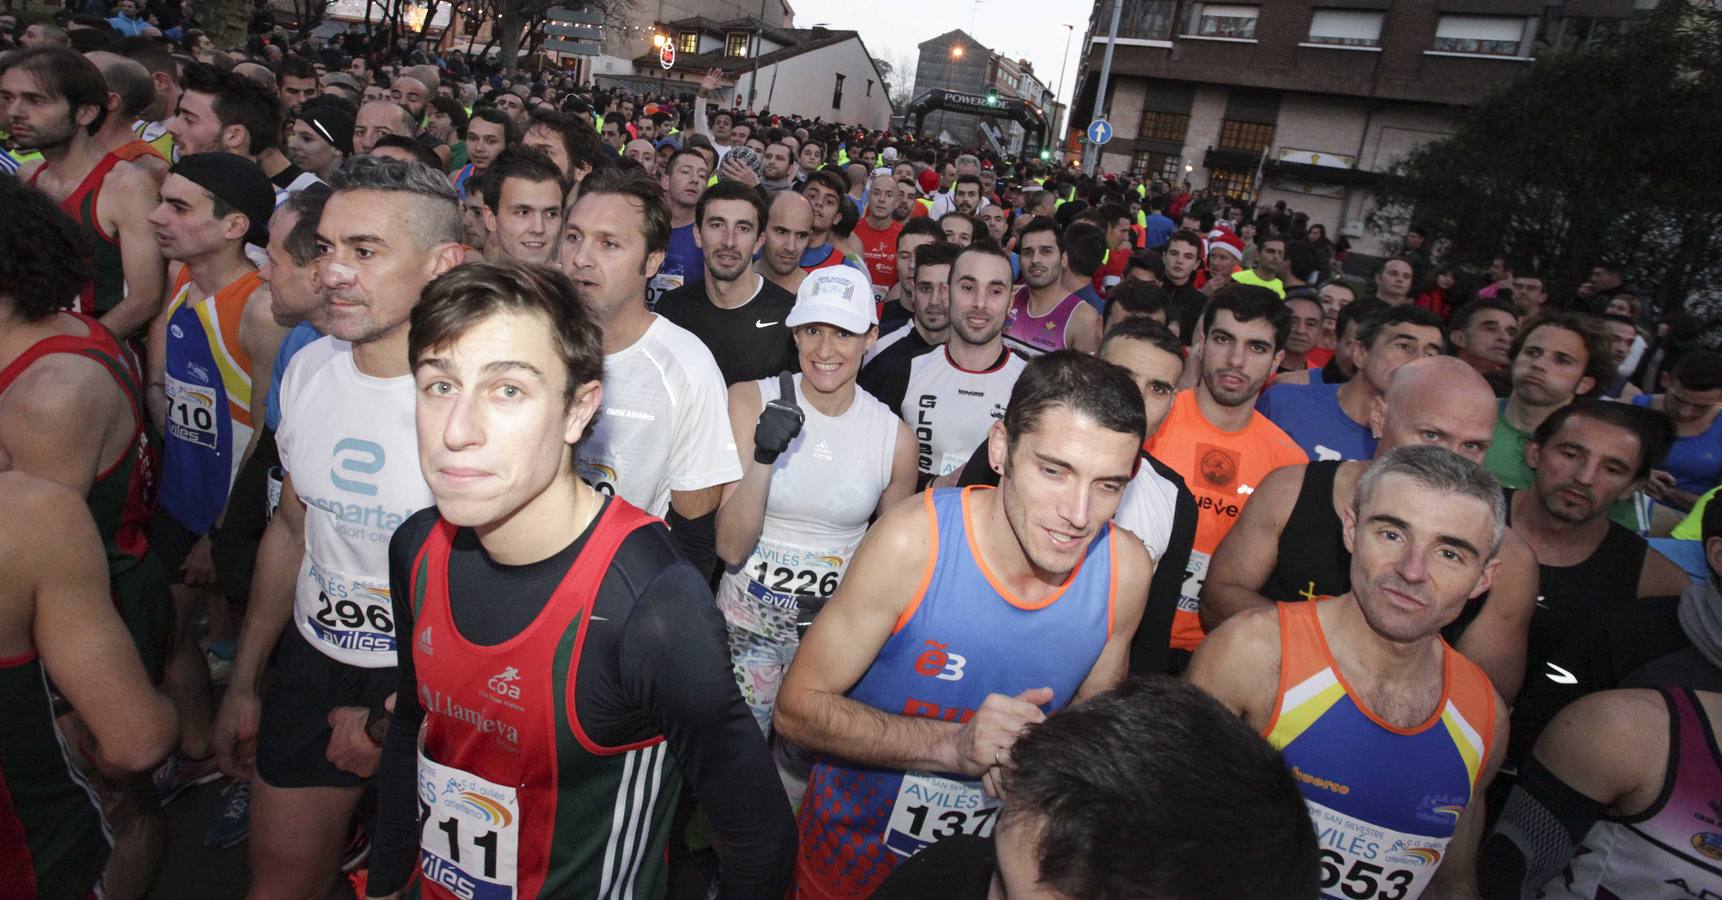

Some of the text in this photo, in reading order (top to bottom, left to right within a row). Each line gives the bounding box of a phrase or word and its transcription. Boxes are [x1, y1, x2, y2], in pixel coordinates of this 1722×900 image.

[754, 561, 839, 597] 1226
[316, 591, 394, 633] 296
[323, 631, 392, 652] avilés
[905, 783, 980, 809] AVILÉS
[1325, 812, 1343, 825] SAN
[1344, 820, 1385, 840] SILVESTRE
